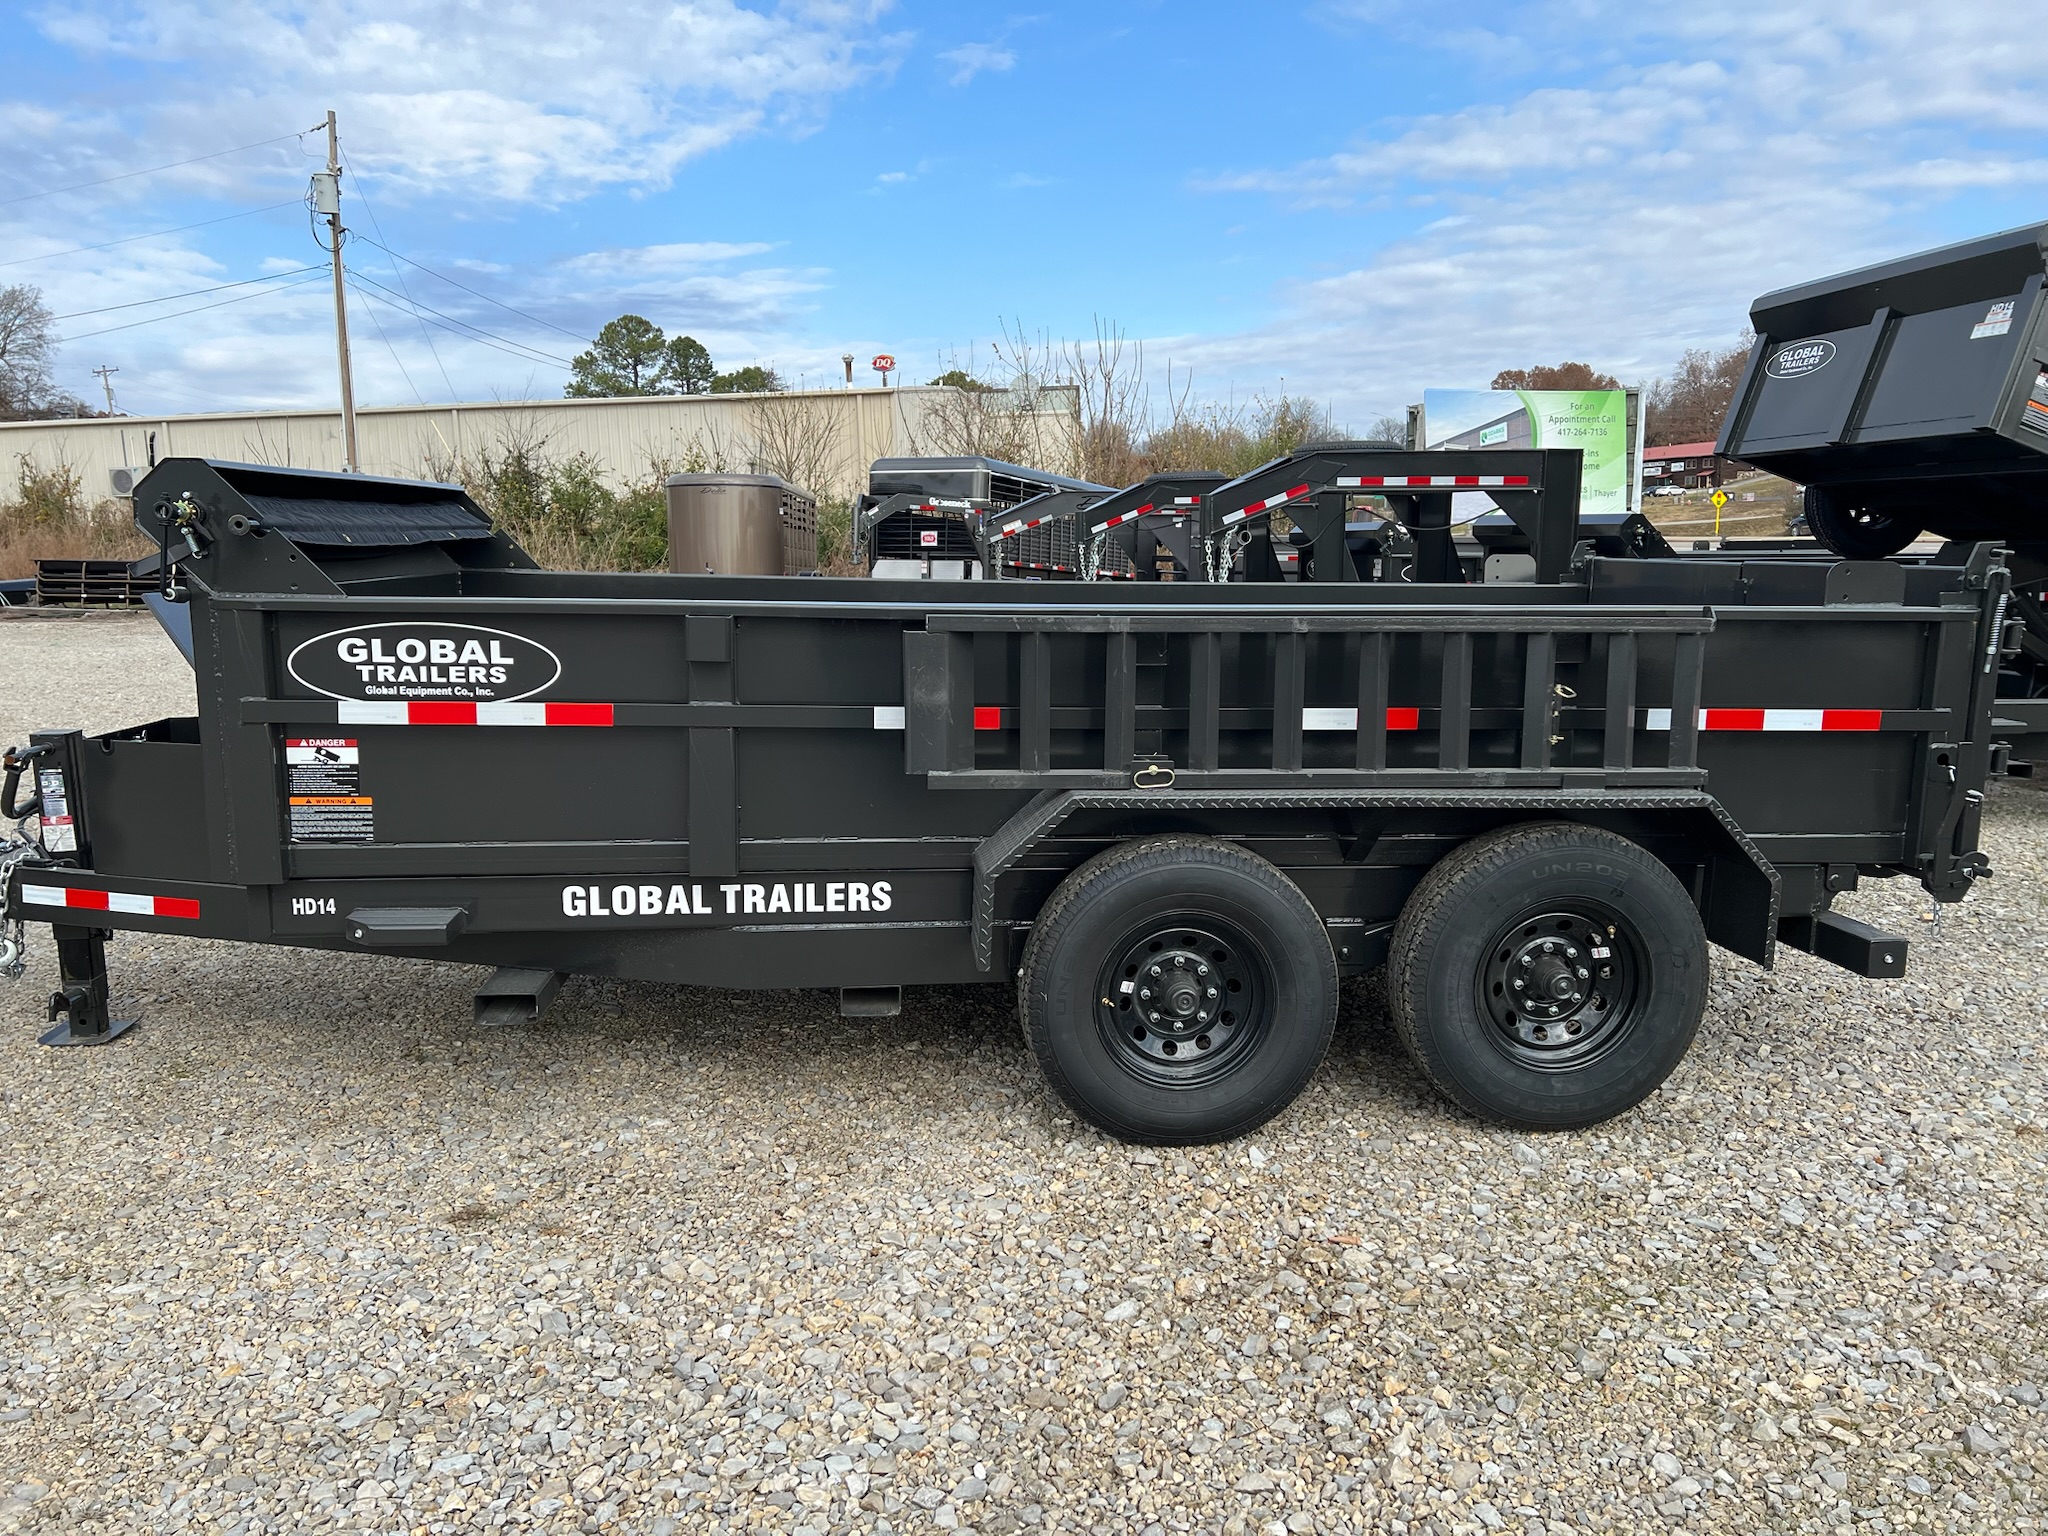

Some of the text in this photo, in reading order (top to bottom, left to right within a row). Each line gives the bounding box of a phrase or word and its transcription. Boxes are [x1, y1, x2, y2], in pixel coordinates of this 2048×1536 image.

[1990, 301, 2015, 313] HD14
[1779, 345, 1824, 362] GLOBAL
[876, 358, 891, 368] DQ
[1781, 356, 1820, 369] TRAILERS
[1549, 416, 1600, 425] Appointment
[1558, 428, 1608, 436] 417-264-7136
[1594, 490, 1617, 498] Thayer
[337, 637, 514, 665] GLOBAL
[356, 665, 508, 684] TRAILERS
[366, 686, 495, 698] Global Equipment Co., Inc.
[309, 738, 346, 746] DANGER
[1530, 863, 1630, 880] UN203
[562, 882, 892, 916] GLOBAL TRAILERS
[291, 897, 336, 914] HD14
